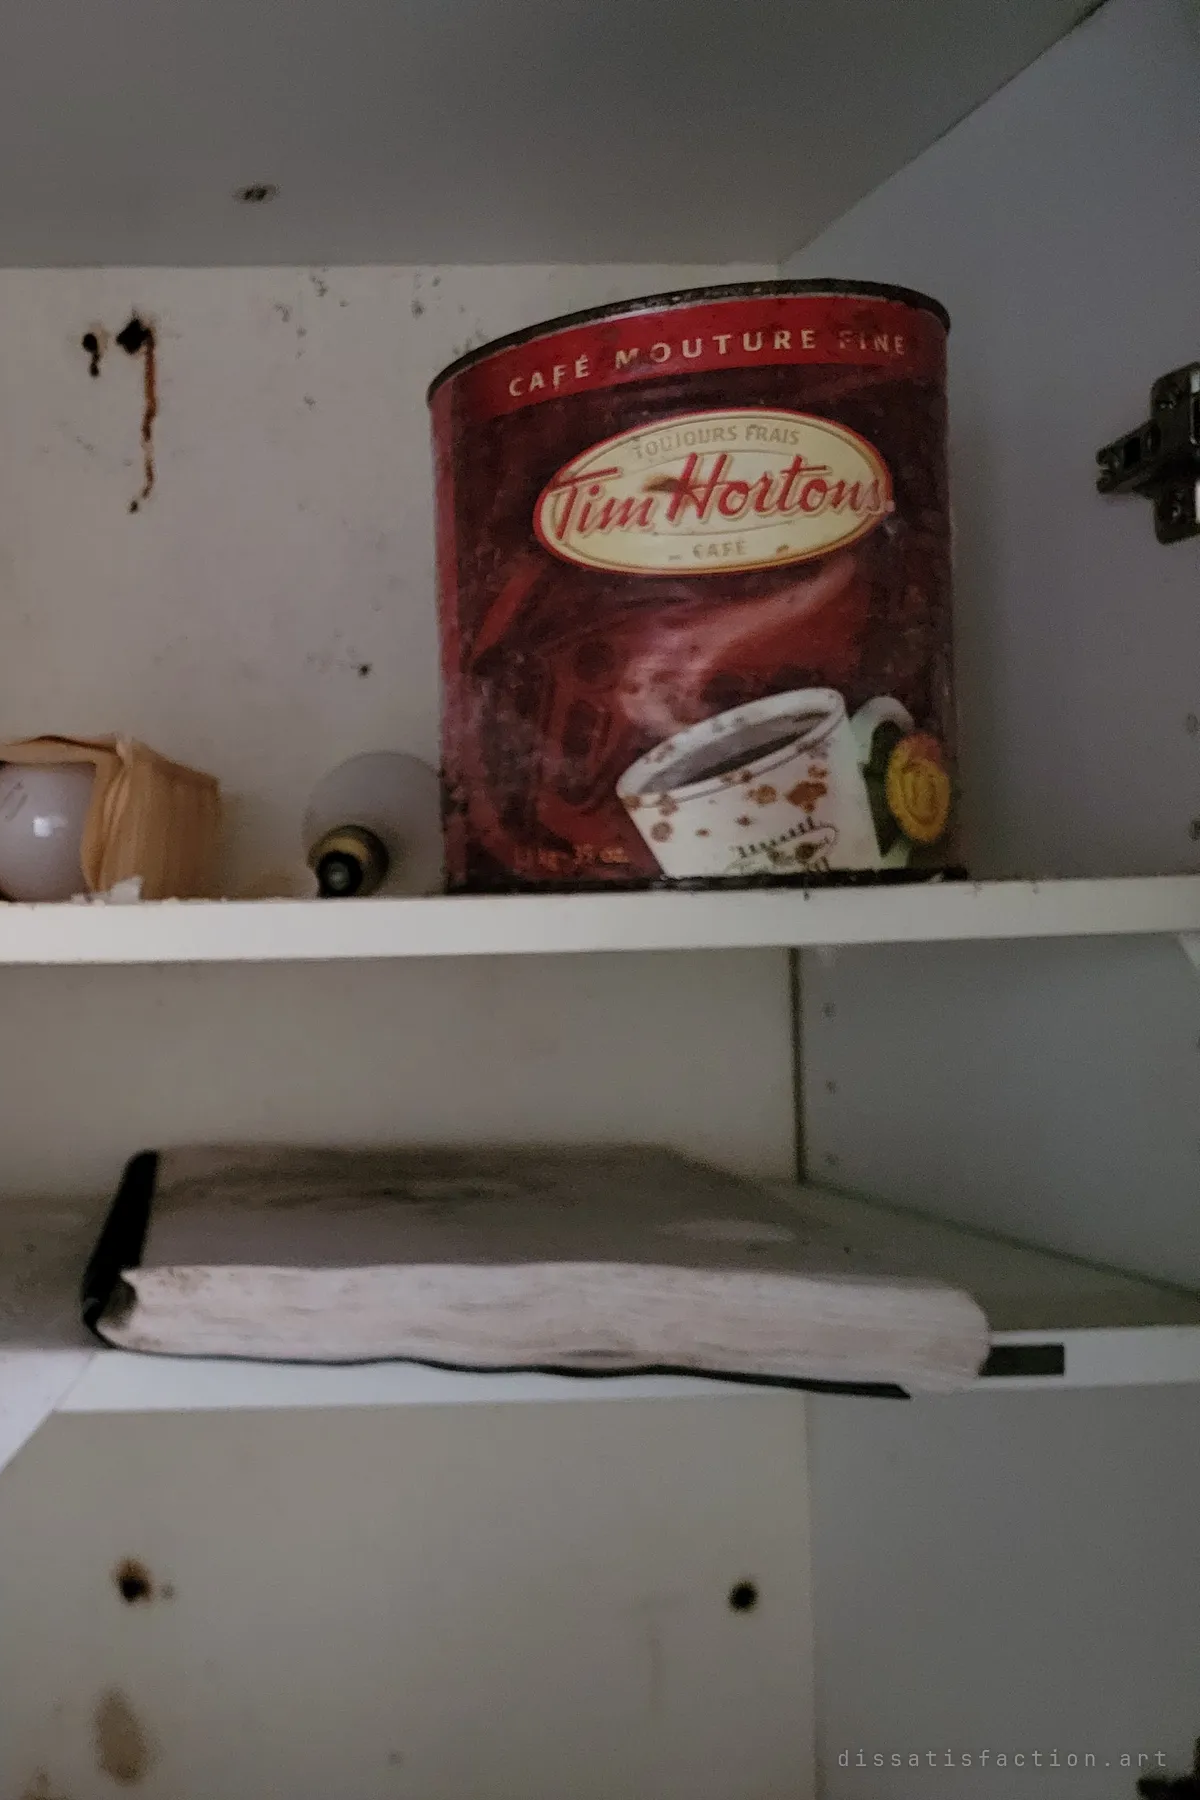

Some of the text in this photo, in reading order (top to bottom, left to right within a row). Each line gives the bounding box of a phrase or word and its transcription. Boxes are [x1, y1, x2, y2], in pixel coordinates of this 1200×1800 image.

[507, 329, 907, 400] CAFÉ MOUTURE FINE
[632, 422, 801, 461] TOUJOURS FRAIS
[552, 451, 892, 542] Tim Hortons
